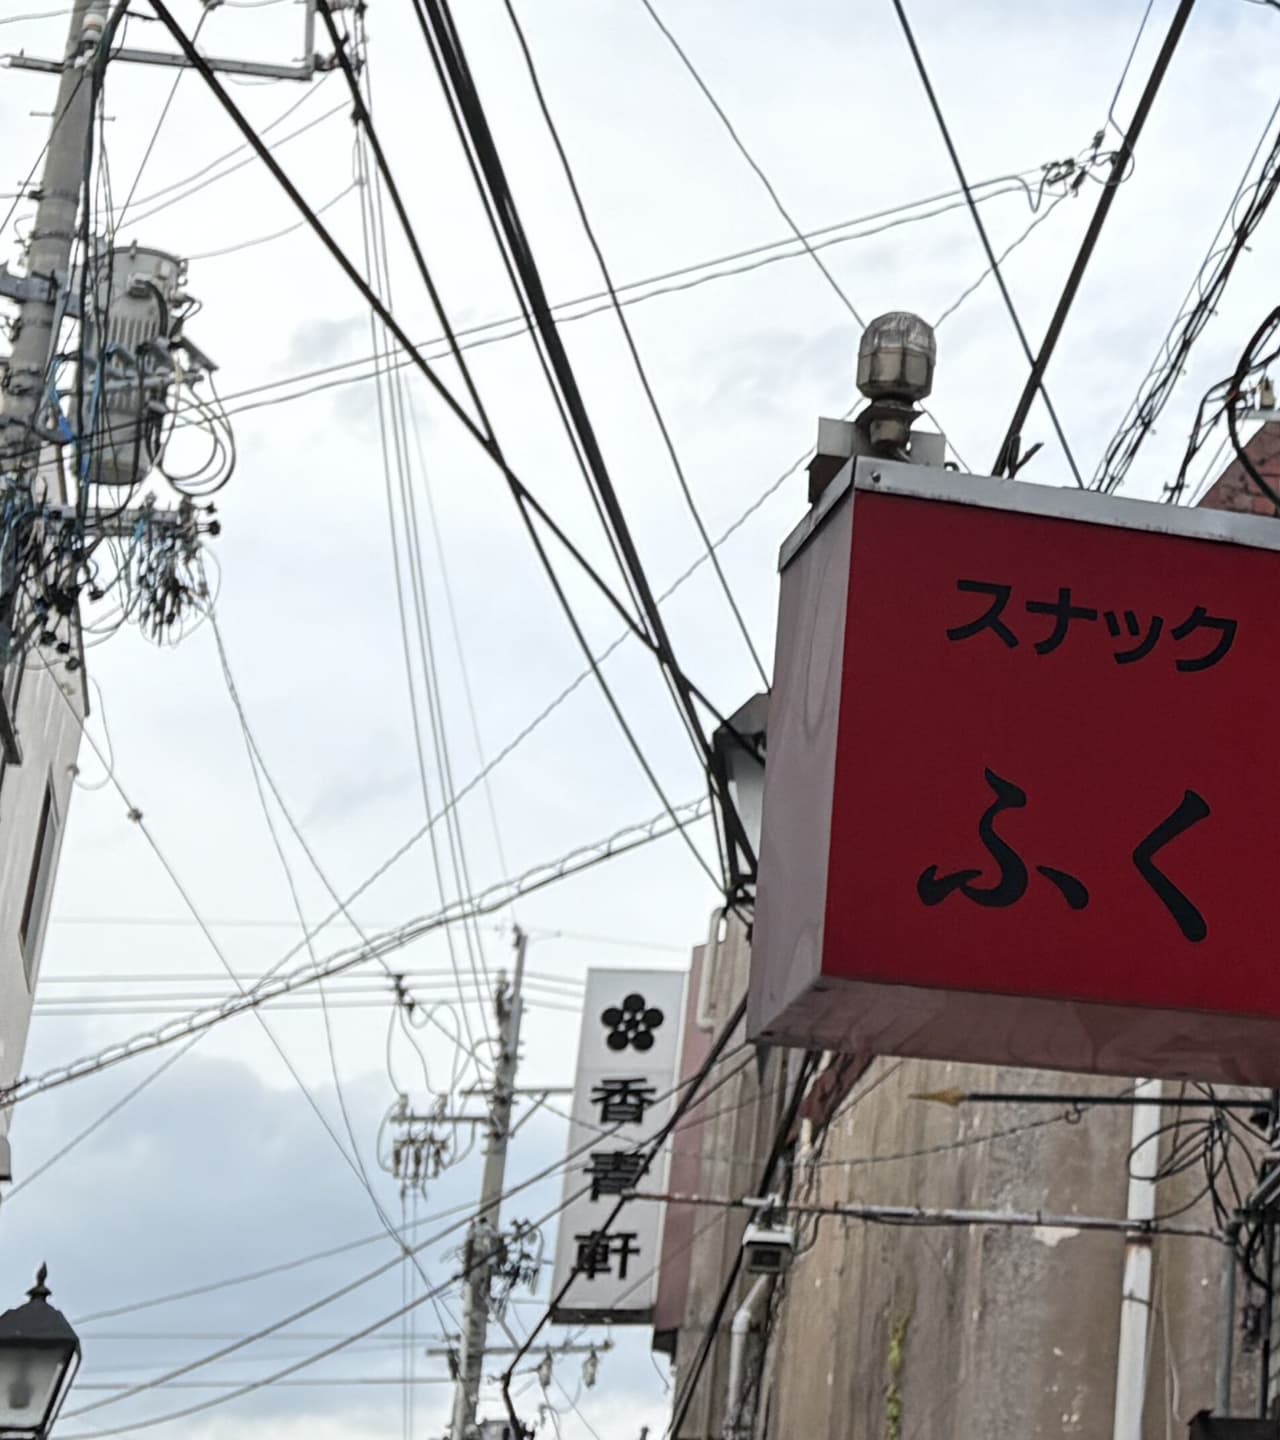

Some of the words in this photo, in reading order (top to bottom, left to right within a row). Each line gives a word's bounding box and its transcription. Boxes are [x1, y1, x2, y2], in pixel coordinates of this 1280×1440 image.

[945, 576, 1239, 674] スナック
[915, 767, 1212, 944] ふく
